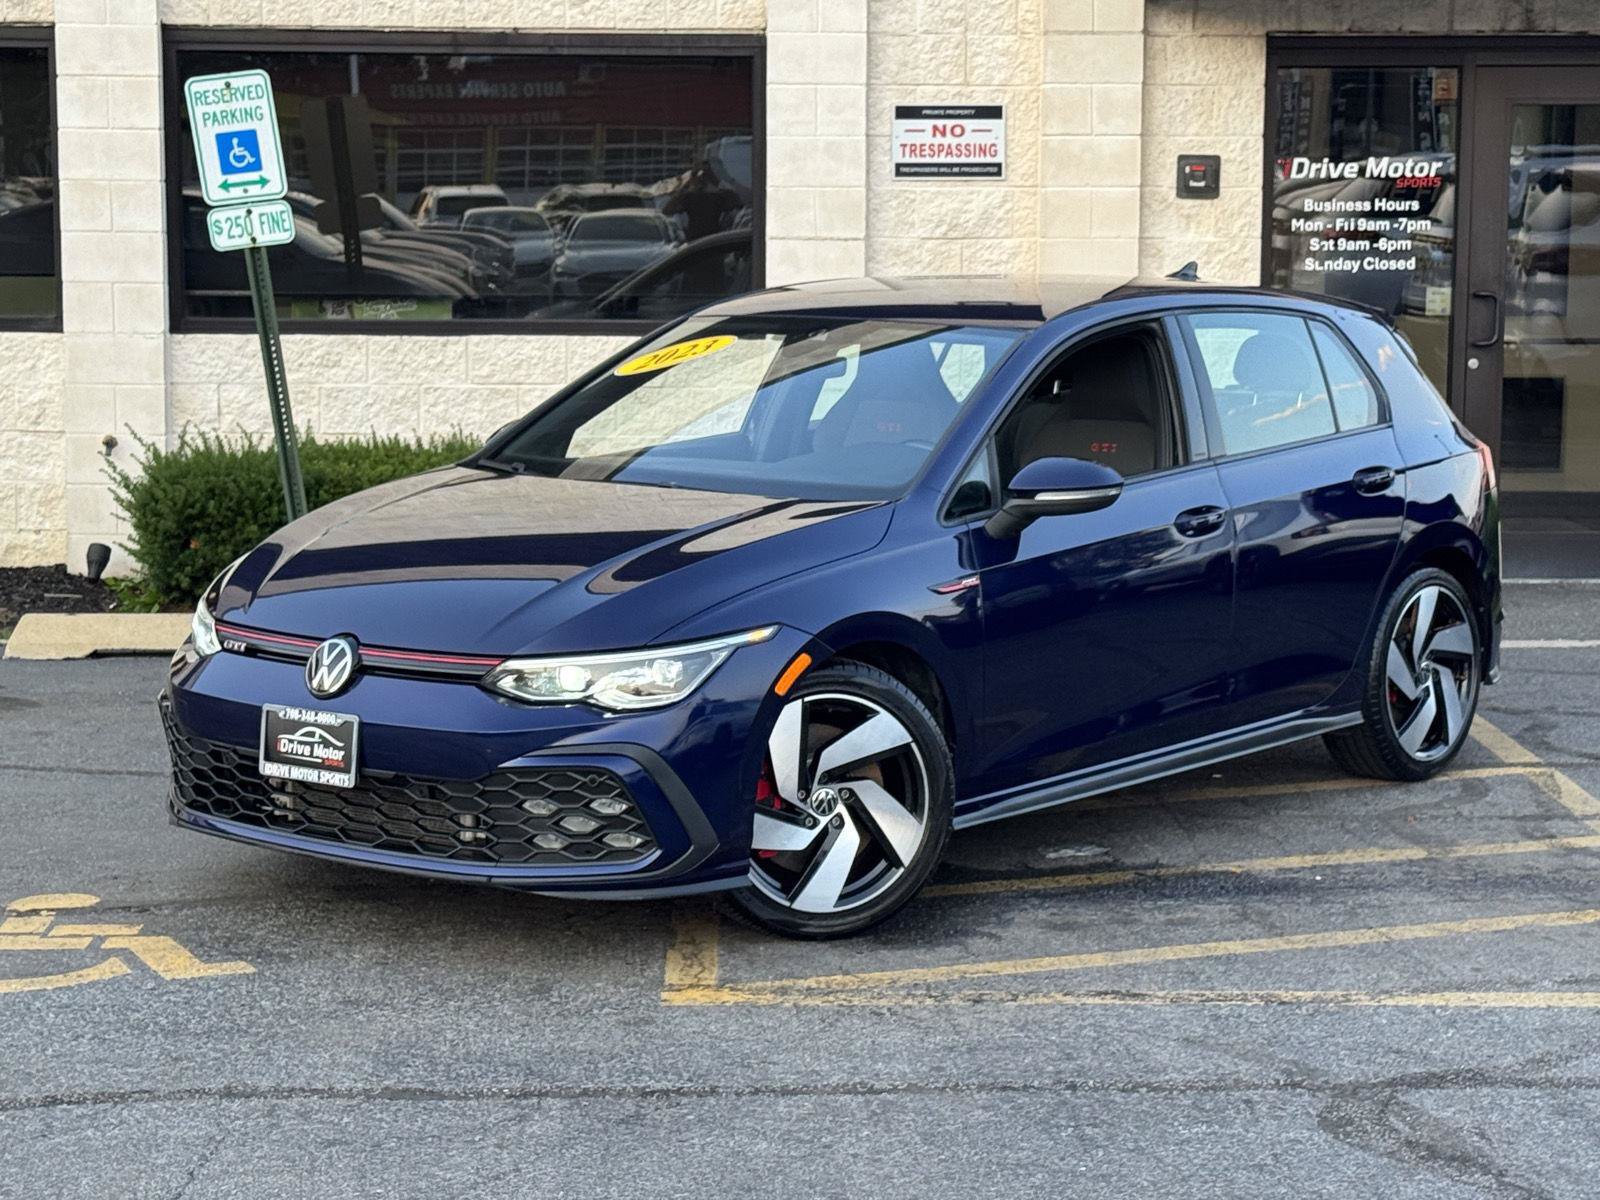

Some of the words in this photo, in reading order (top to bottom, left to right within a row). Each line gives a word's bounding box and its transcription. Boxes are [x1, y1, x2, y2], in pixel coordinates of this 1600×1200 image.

[194, 84, 265, 107] RESERVED
[202, 105, 264, 128] PARKING
[931, 124, 966, 138] NO
[900, 143, 998, 158] TRESPASSING
[1365, 156, 1444, 179] Motor
[1395, 177, 1443, 188] SPORTS
[1304, 198, 1371, 212] Business
[1374, 198, 1420, 211] Hours
[213, 213, 254, 239] $250
[258, 210, 291, 235] FINE
[1291, 218, 1323, 231] Mon
[1335, 218, 1355, 231] Fri
[1357, 218, 1391, 231] 9am
[1337, 238, 1371, 251] 9am
[1363, 256, 1417, 270] Closed
[223, 638, 247, 652] GTI
[313, 742, 345, 761] Motor
[290, 766, 319, 783] MOTOR
[319, 770, 350, 787] SPORTS
